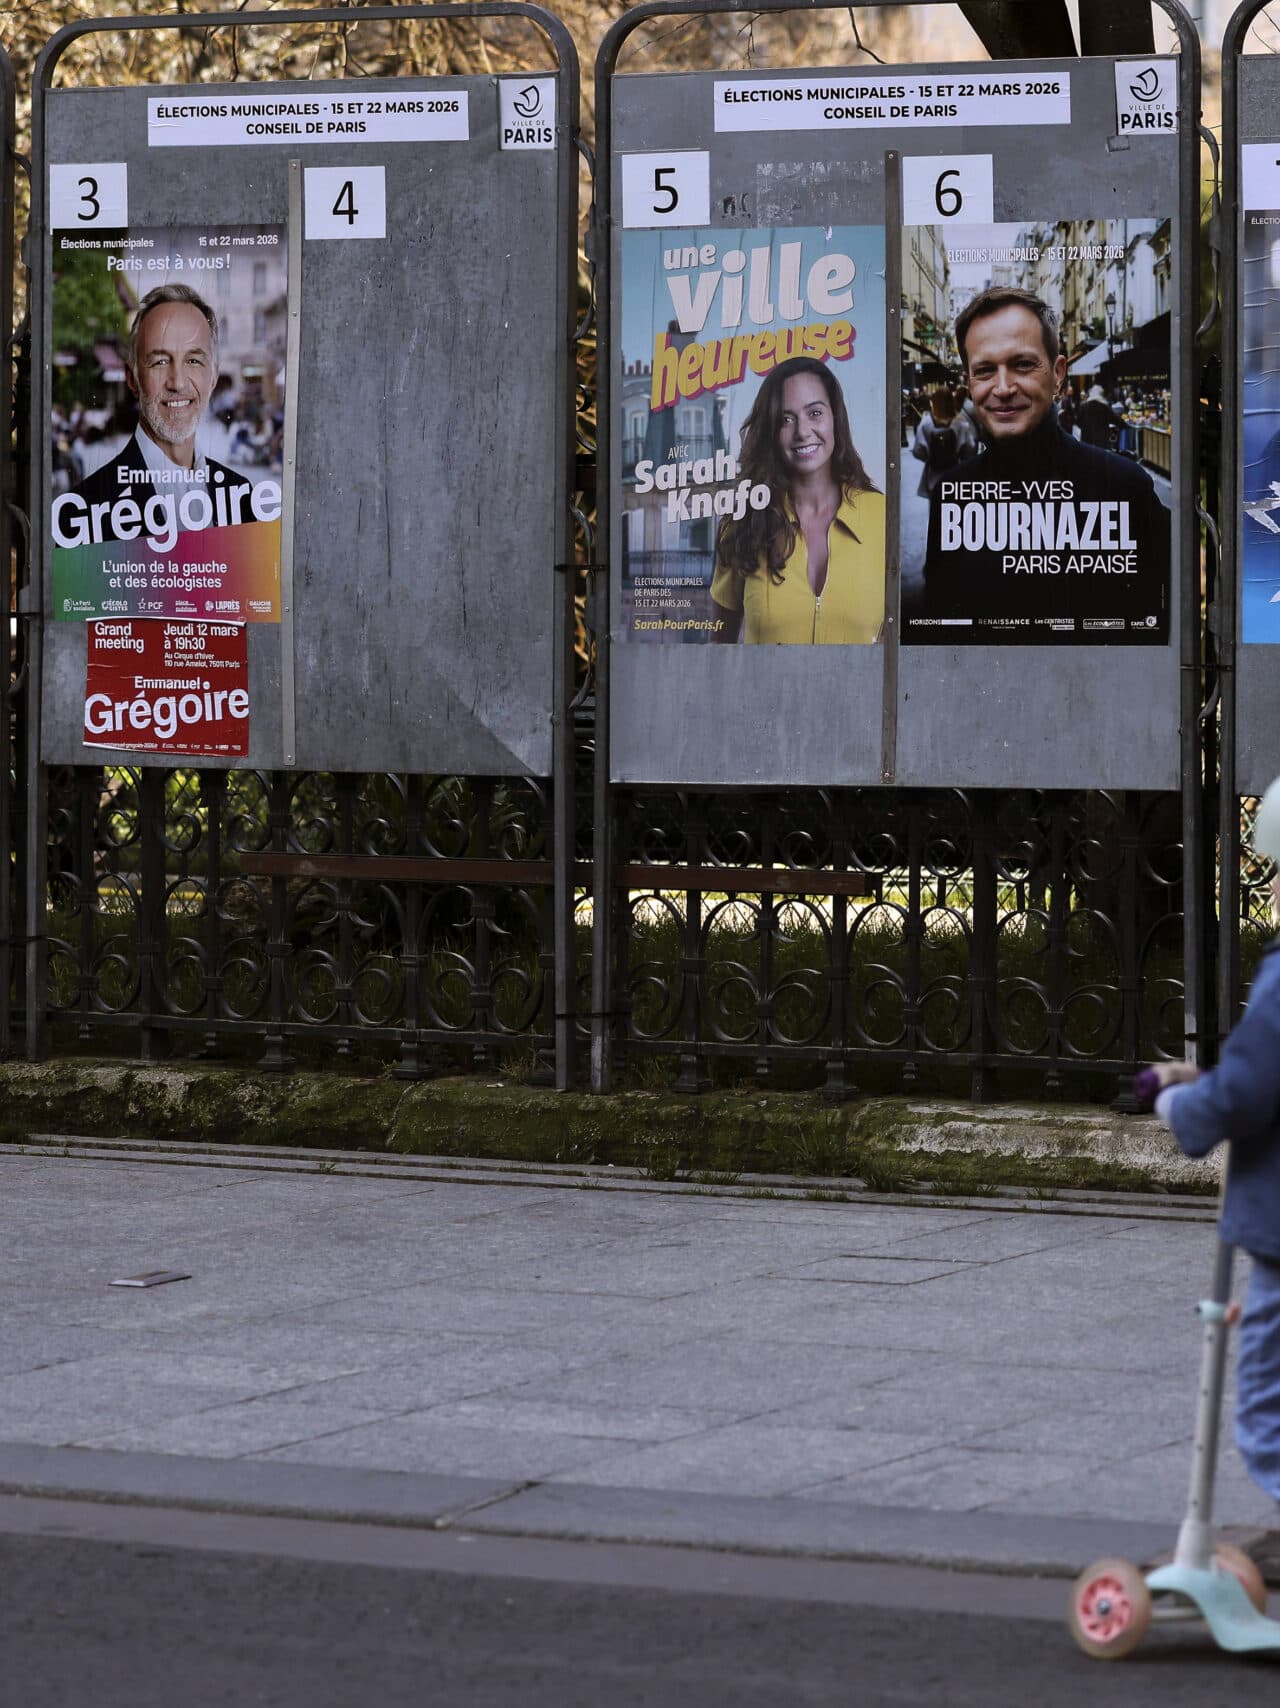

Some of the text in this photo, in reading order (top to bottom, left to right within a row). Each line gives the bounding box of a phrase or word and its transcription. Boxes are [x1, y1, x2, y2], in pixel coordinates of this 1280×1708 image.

[724, 82, 1060, 104] ÉLECTIONS MUNICIPALES 15 ET 22 MARS 2026
[157, 100, 459, 118] ÉLECTIONS MUNICIPALES 15 ET 22 MARS 2026
[824, 104, 958, 120] CONSEIL DE PARIS
[246, 121, 366, 135] CONSEIL DE PARIS
[1121, 112, 1174, 129] PARIS
[504, 128, 552, 144] PARIS
[78, 177, 99, 220] 3
[654, 168, 678, 213] 5
[936, 170, 962, 216] 6
[333, 181, 358, 224] 4
[61, 236, 154, 251] Élections municipales
[198, 235, 278, 247] 15 et 22 mars 2026
[663, 243, 717, 270] une
[988, 245, 1124, 262] MUNICIPALES 15 ET 22 MARS 2026
[107, 255, 142, 272] Paris
[147, 256, 170, 271] est
[175, 254, 184, 270] à
[666, 241, 857, 333] ville
[650, 319, 857, 413] heureuse
[668, 445, 689, 459] AVEC
[117, 465, 209, 484] Emmanuel
[635, 449, 736, 493] Sarah
[941, 481, 1075, 500] PIERRE-YVES
[667, 479, 771, 523] Knafo
[51, 470, 282, 553] Grégoire
[941, 501, 1137, 551] BOURNAZEL
[103, 560, 227, 577] L'union de la gauche
[1002, 550, 1138, 575] PARIS APAISÉ
[109, 575, 222, 592] et des écologistes
[665, 577, 704, 586] MUNICIPALES
[634, 588, 672, 597] DE PARIS DES
[148, 601, 163, 610] PCF
[635, 599, 691, 607] 15 ET 22 MARS 2026
[95, 622, 132, 636] Grand
[164, 623, 239, 637] Jeudi 12 mars
[634, 619, 724, 632] SarahPourParis.fr
[95, 636, 144, 653] meeting
[164, 637, 206, 650] à 19h30
[164, 652, 173, 660] Au
[174, 652, 193, 661] Cirque
[225, 661, 241, 669] Paris
[134, 675, 200, 690] Emmanuel
[85, 681, 249, 739] Grégoire
